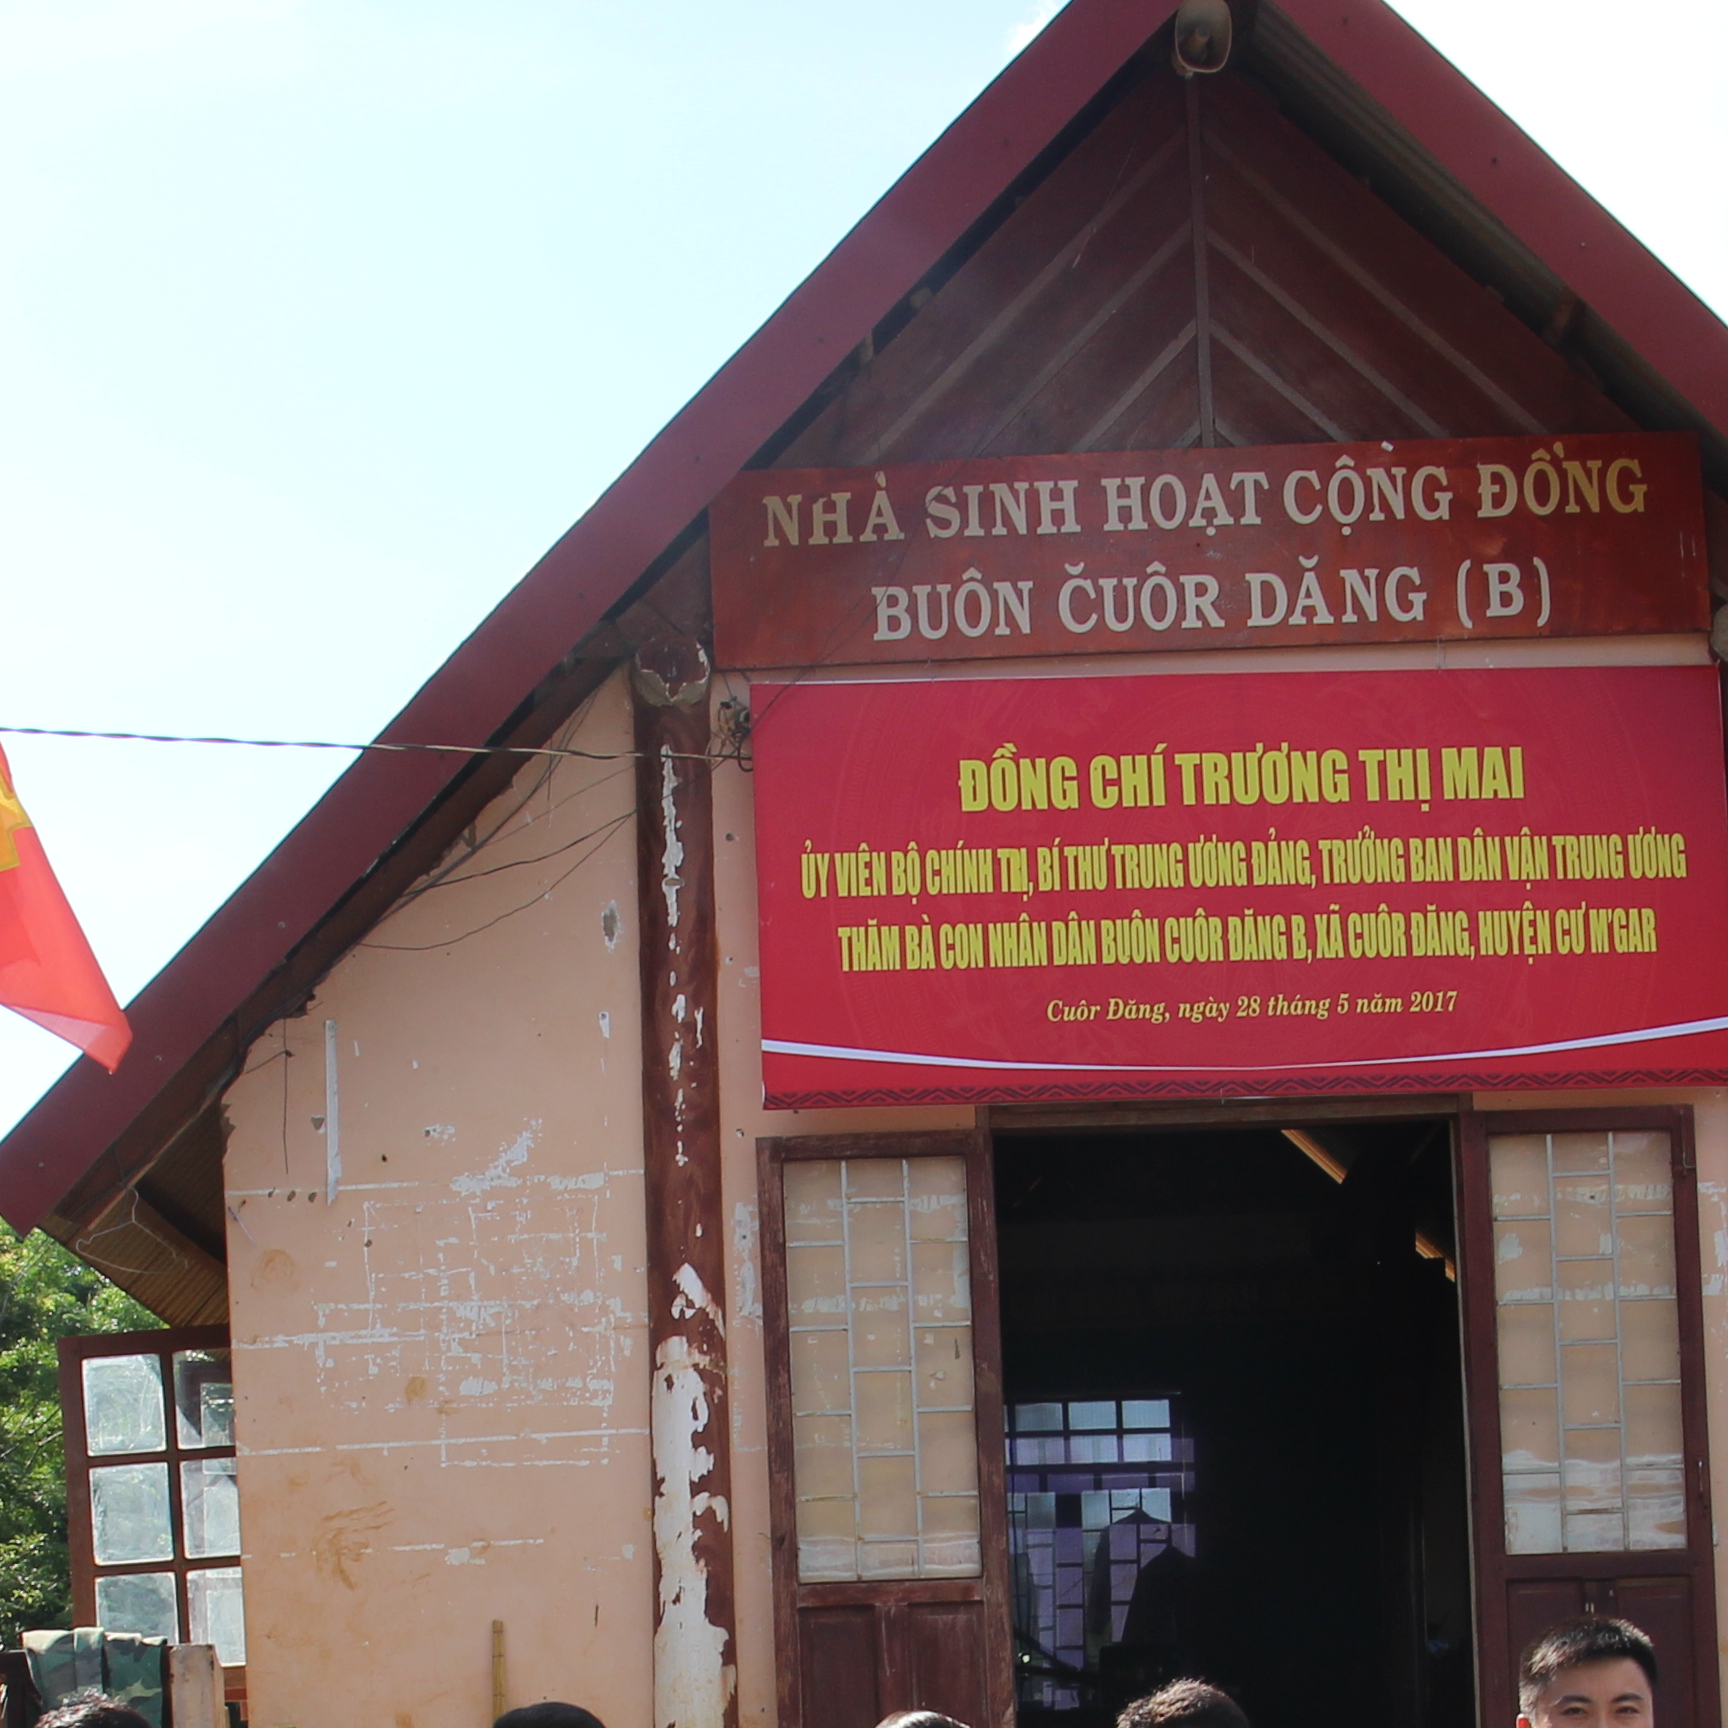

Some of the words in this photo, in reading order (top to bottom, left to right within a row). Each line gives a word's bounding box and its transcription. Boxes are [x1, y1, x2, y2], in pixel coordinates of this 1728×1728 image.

[762, 471, 905, 547] NHÀ
[925, 479, 1082, 539] SINH
[1100, 471, 1269, 536] HOẠT
[1282, 454, 1453, 536] CỘNG
[1477, 441, 1648, 518] ĐỒNG
[872, 567, 1033, 641] BUÔN
[958, 742, 1079, 812] ĐỒNG
[1089, 743, 1168, 809] CHÍ
[1174, 742, 1350, 806] TRƯƠNG
[1358, 748, 1432, 812] THỊ
[1441, 746, 1525, 800] MAI
[801, 839, 831, 899] ỦY
[834, 842, 887, 897] VIÊN
[891, 841, 921, 905] BỘ
[925, 840, 994, 895] CHÍNH
[997, 847, 1034, 902] TRỊ,
[1037, 837, 1061, 892] BÍ
[1063, 837, 1109, 891] THƯ
[1111, 843, 1184, 889] TRUNG
[1187, 834, 1248, 888] ƯƠNG
[1251, 827, 1316, 889] ĐẢNG,
[1318, 825, 1406, 884] TRƯỞNG
[1409, 837, 1454, 882] BAN
[1457, 827, 1502, 881] DÂN
[1504, 826, 1550, 890] VẬN
[1552, 833, 1624, 880] TRUNG
[1627, 826, 1687, 879] ƯƠNG
[837, 918, 901, 971] THĂM
[905, 914, 936, 970] BÀ
[939, 922, 984, 969] CON
[988, 912, 1048, 967] NHÂN
[1051, 911, 1097, 965] DÂN
[1101, 909, 1160, 964] BUÔN
[1164, 907, 1224, 963] CUÔR
[1228, 908, 1287, 961] ĐĂNG
[1291, 914, 1312, 964] B,
[1315, 904, 1345, 958] XÃ
[1347, 903, 1407, 958] CUÔR
[1410, 904, 1475, 960] ĐĂNG,
[1478, 900, 1552, 965] HUYỆN
[1555, 901, 1586, 954] CƯ
[1046, 999, 1100, 1022] Cuôr
[1106, 998, 1171, 1023] Đăng,
[1177, 995, 1230, 1023] ngày
[1236, 995, 1260, 1017] 28
[1267, 992, 1331, 1019] tháng
[1337, 993, 1349, 1014] 5
[1356, 992, 1404, 1014] năm
[1409, 990, 1457, 1013] 2017
